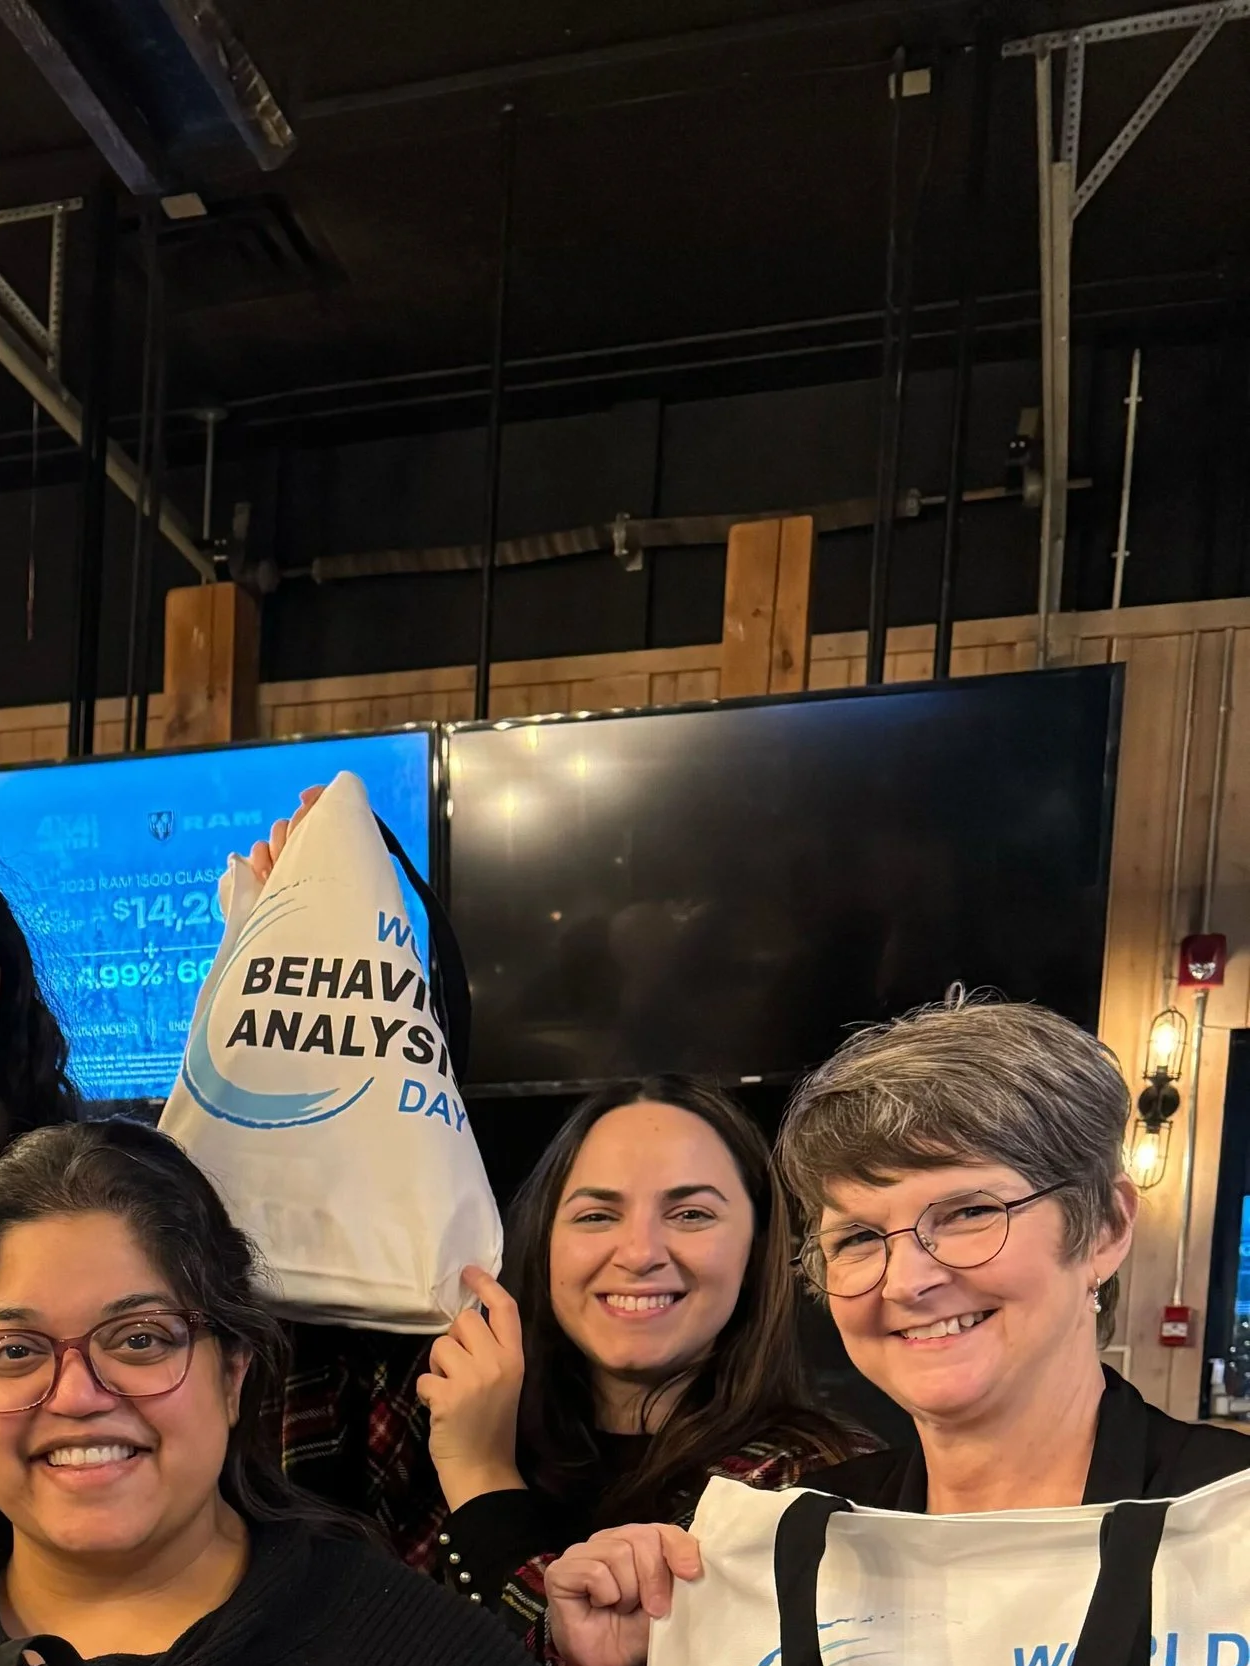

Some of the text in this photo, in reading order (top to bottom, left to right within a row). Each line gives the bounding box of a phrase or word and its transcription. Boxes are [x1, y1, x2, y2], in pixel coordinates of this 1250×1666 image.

[182, 808, 263, 831] RAM
[59, 879, 96, 893] 2023
[99, 875, 132, 890] RAM
[135, 872, 171, 888] 1500
[378, 911, 422, 964] W
[242, 956, 440, 1025] BEHAVI
[226, 1008, 459, 1089] ANALYSI
[398, 1079, 468, 1133] DAY
